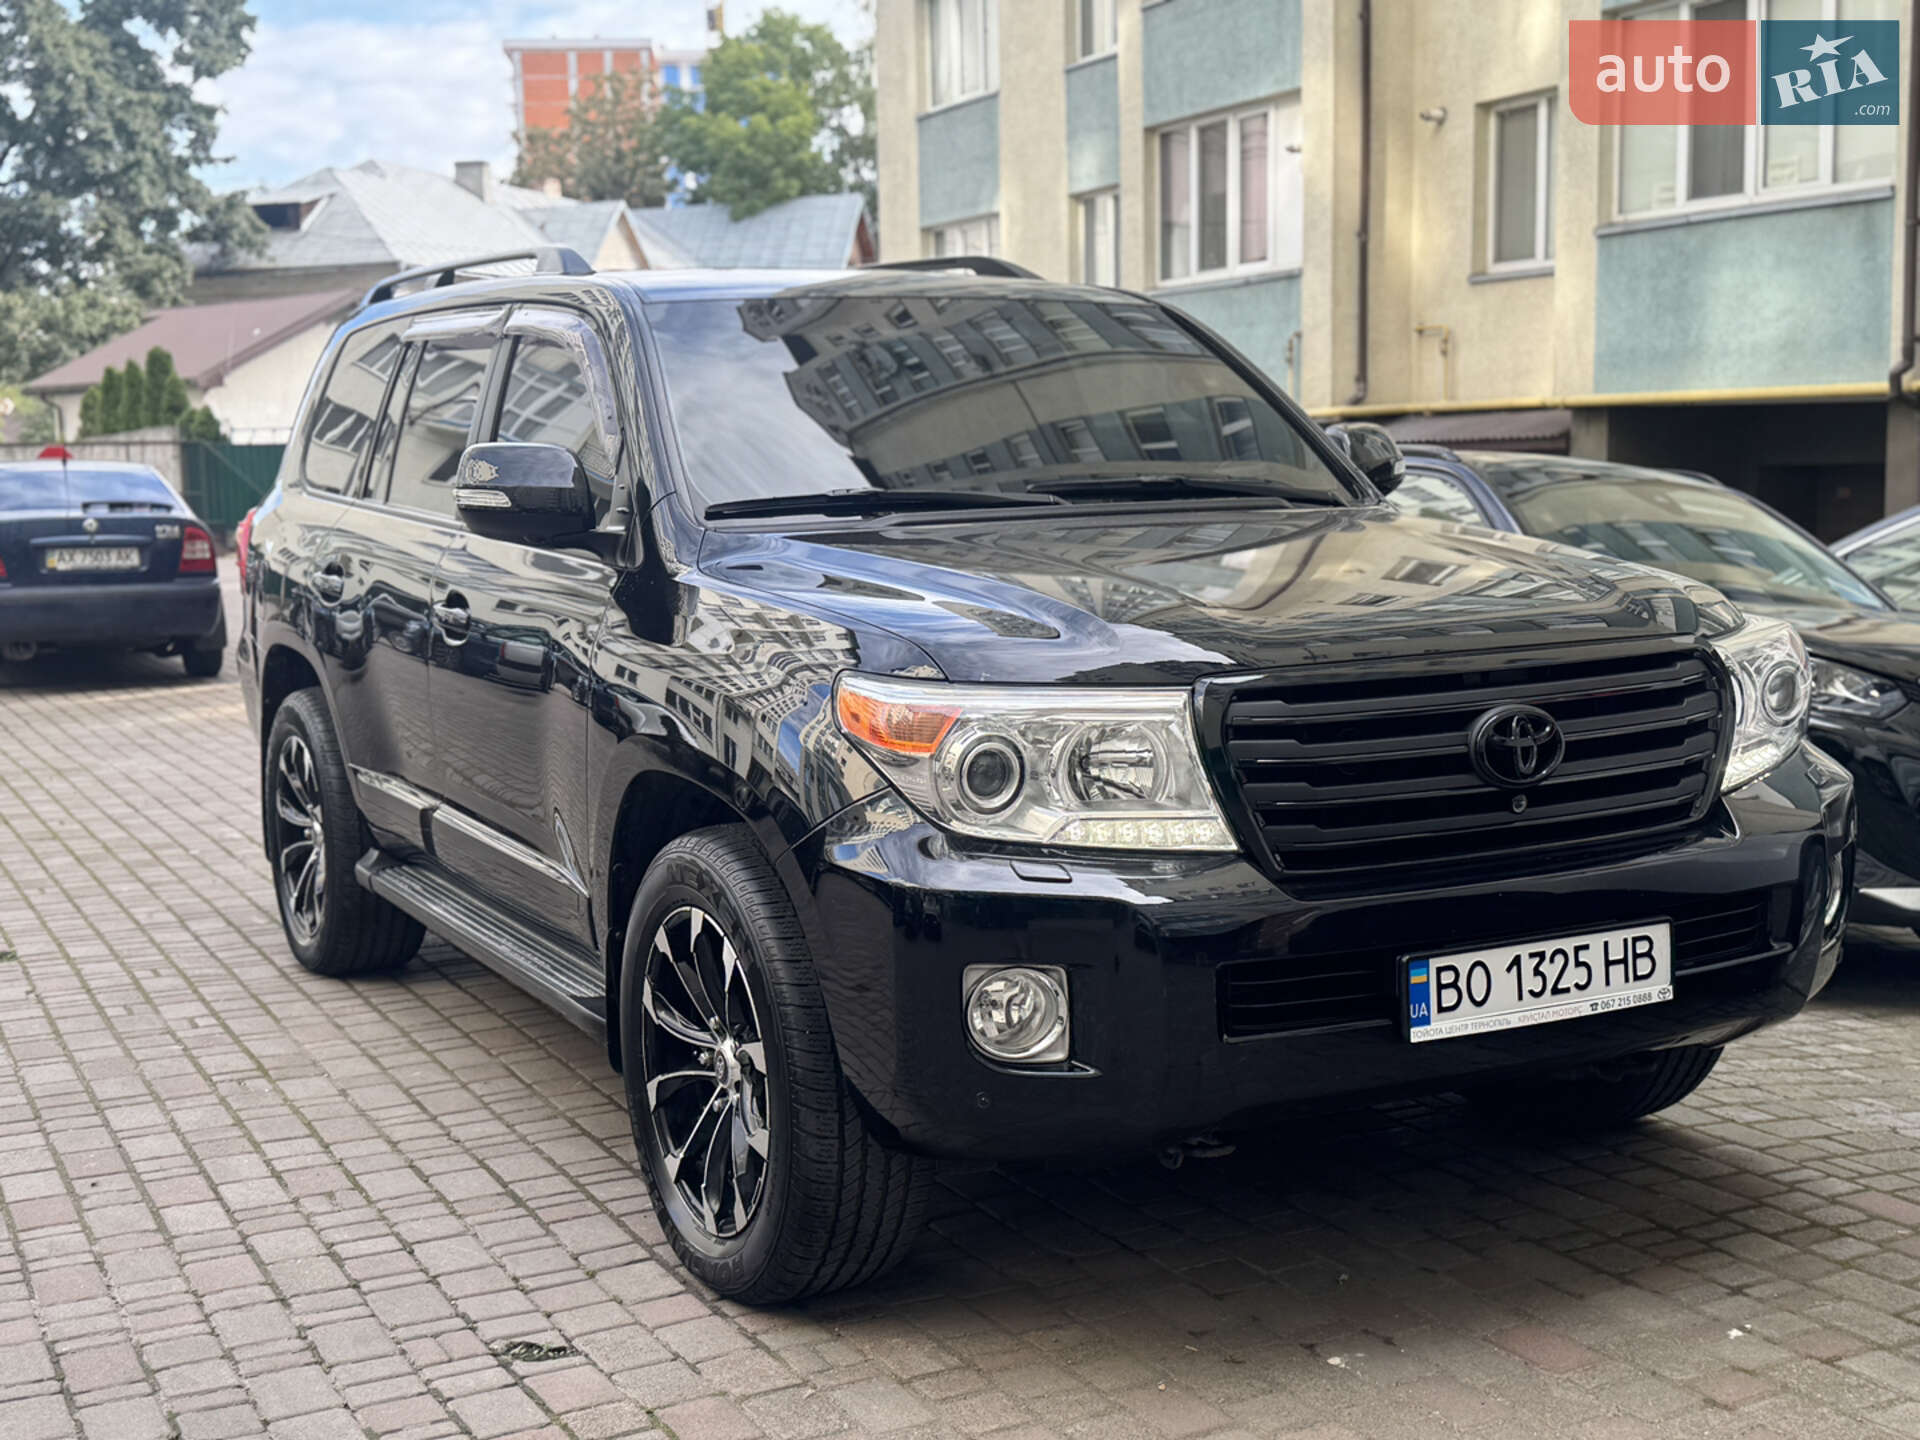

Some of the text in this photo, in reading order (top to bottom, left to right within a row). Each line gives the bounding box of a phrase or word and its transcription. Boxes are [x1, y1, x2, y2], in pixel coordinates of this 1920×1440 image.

[1435, 934, 1657, 1014] BO 1325 HB
[1410, 1003, 1429, 1019] UA
[1600, 998, 1616, 1011] 067
[1617, 995, 1632, 1007] 215
[1632, 992, 1653, 1005] 0888
